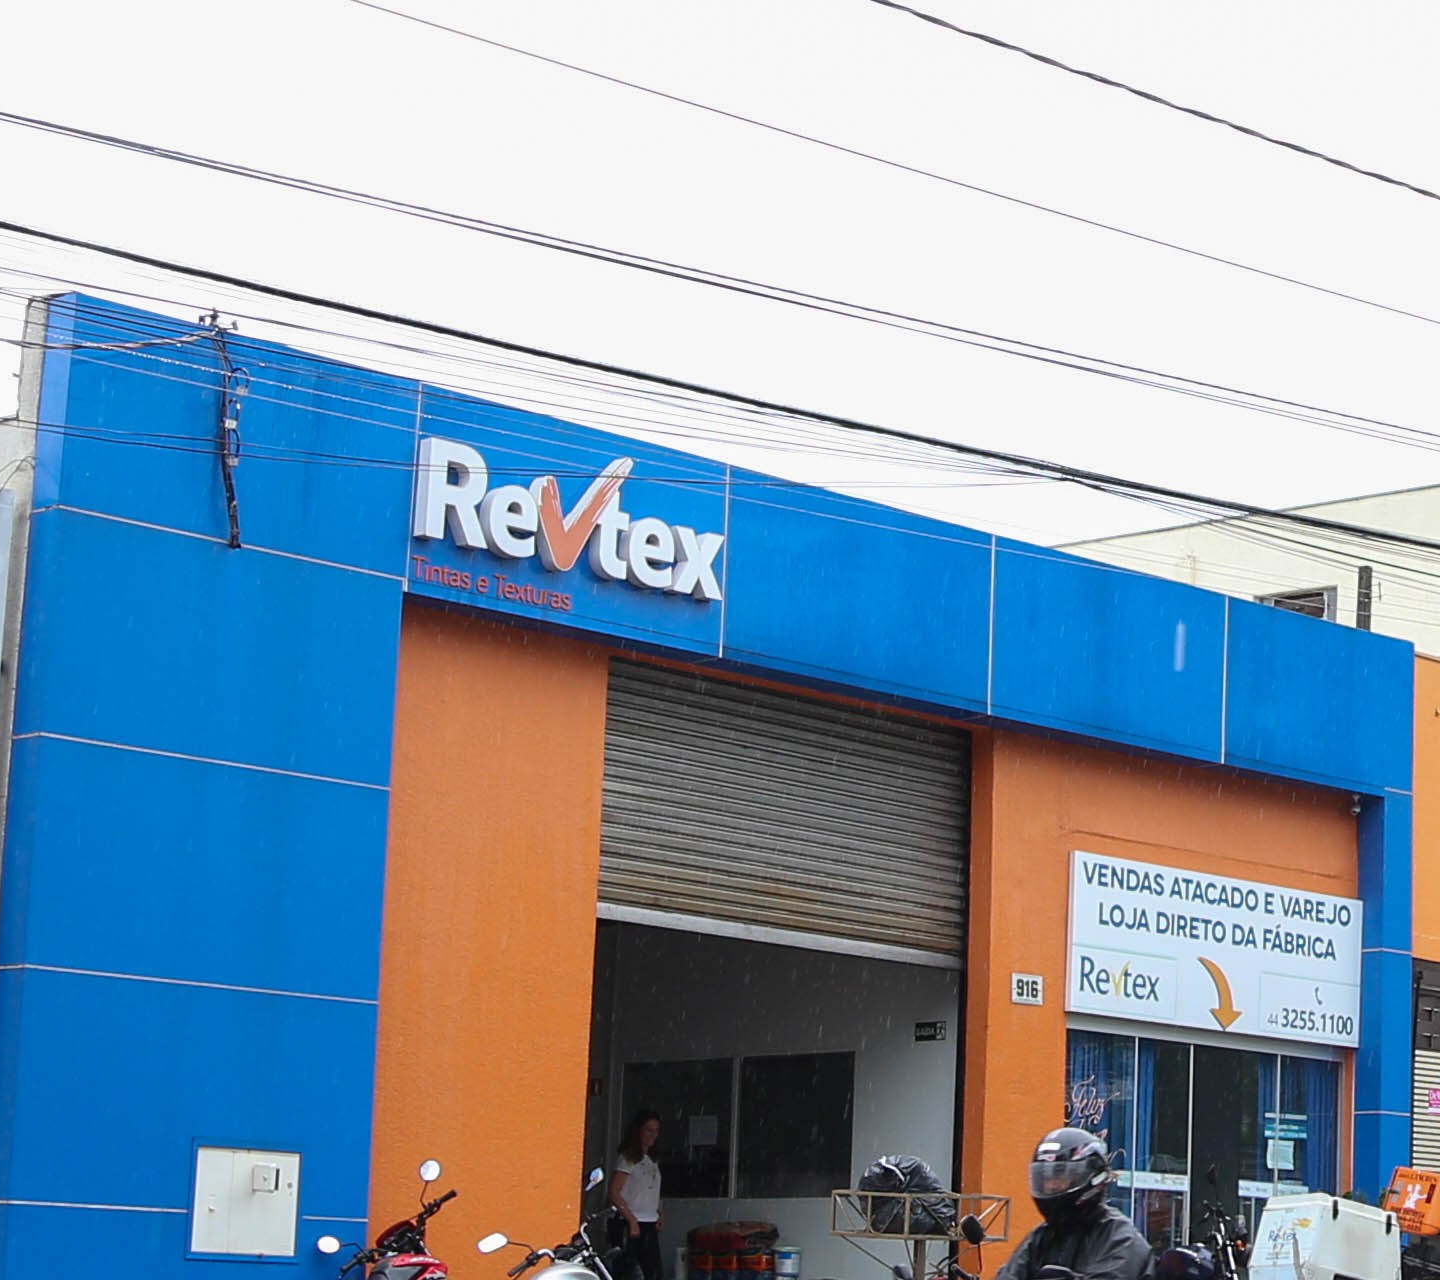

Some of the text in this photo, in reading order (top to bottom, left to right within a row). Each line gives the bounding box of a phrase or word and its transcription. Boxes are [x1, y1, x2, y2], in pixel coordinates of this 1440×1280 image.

[412, 555, 573, 611] Tintas e Texturas
[1083, 861, 1352, 927] VENDAS ATACADO E VAREJO
[1098, 902, 1337, 961] LOJA DIRETO DA FÁBRICA
[1016, 978, 1039, 998] 916
[1281, 1008, 1353, 1036] 3255.1100
